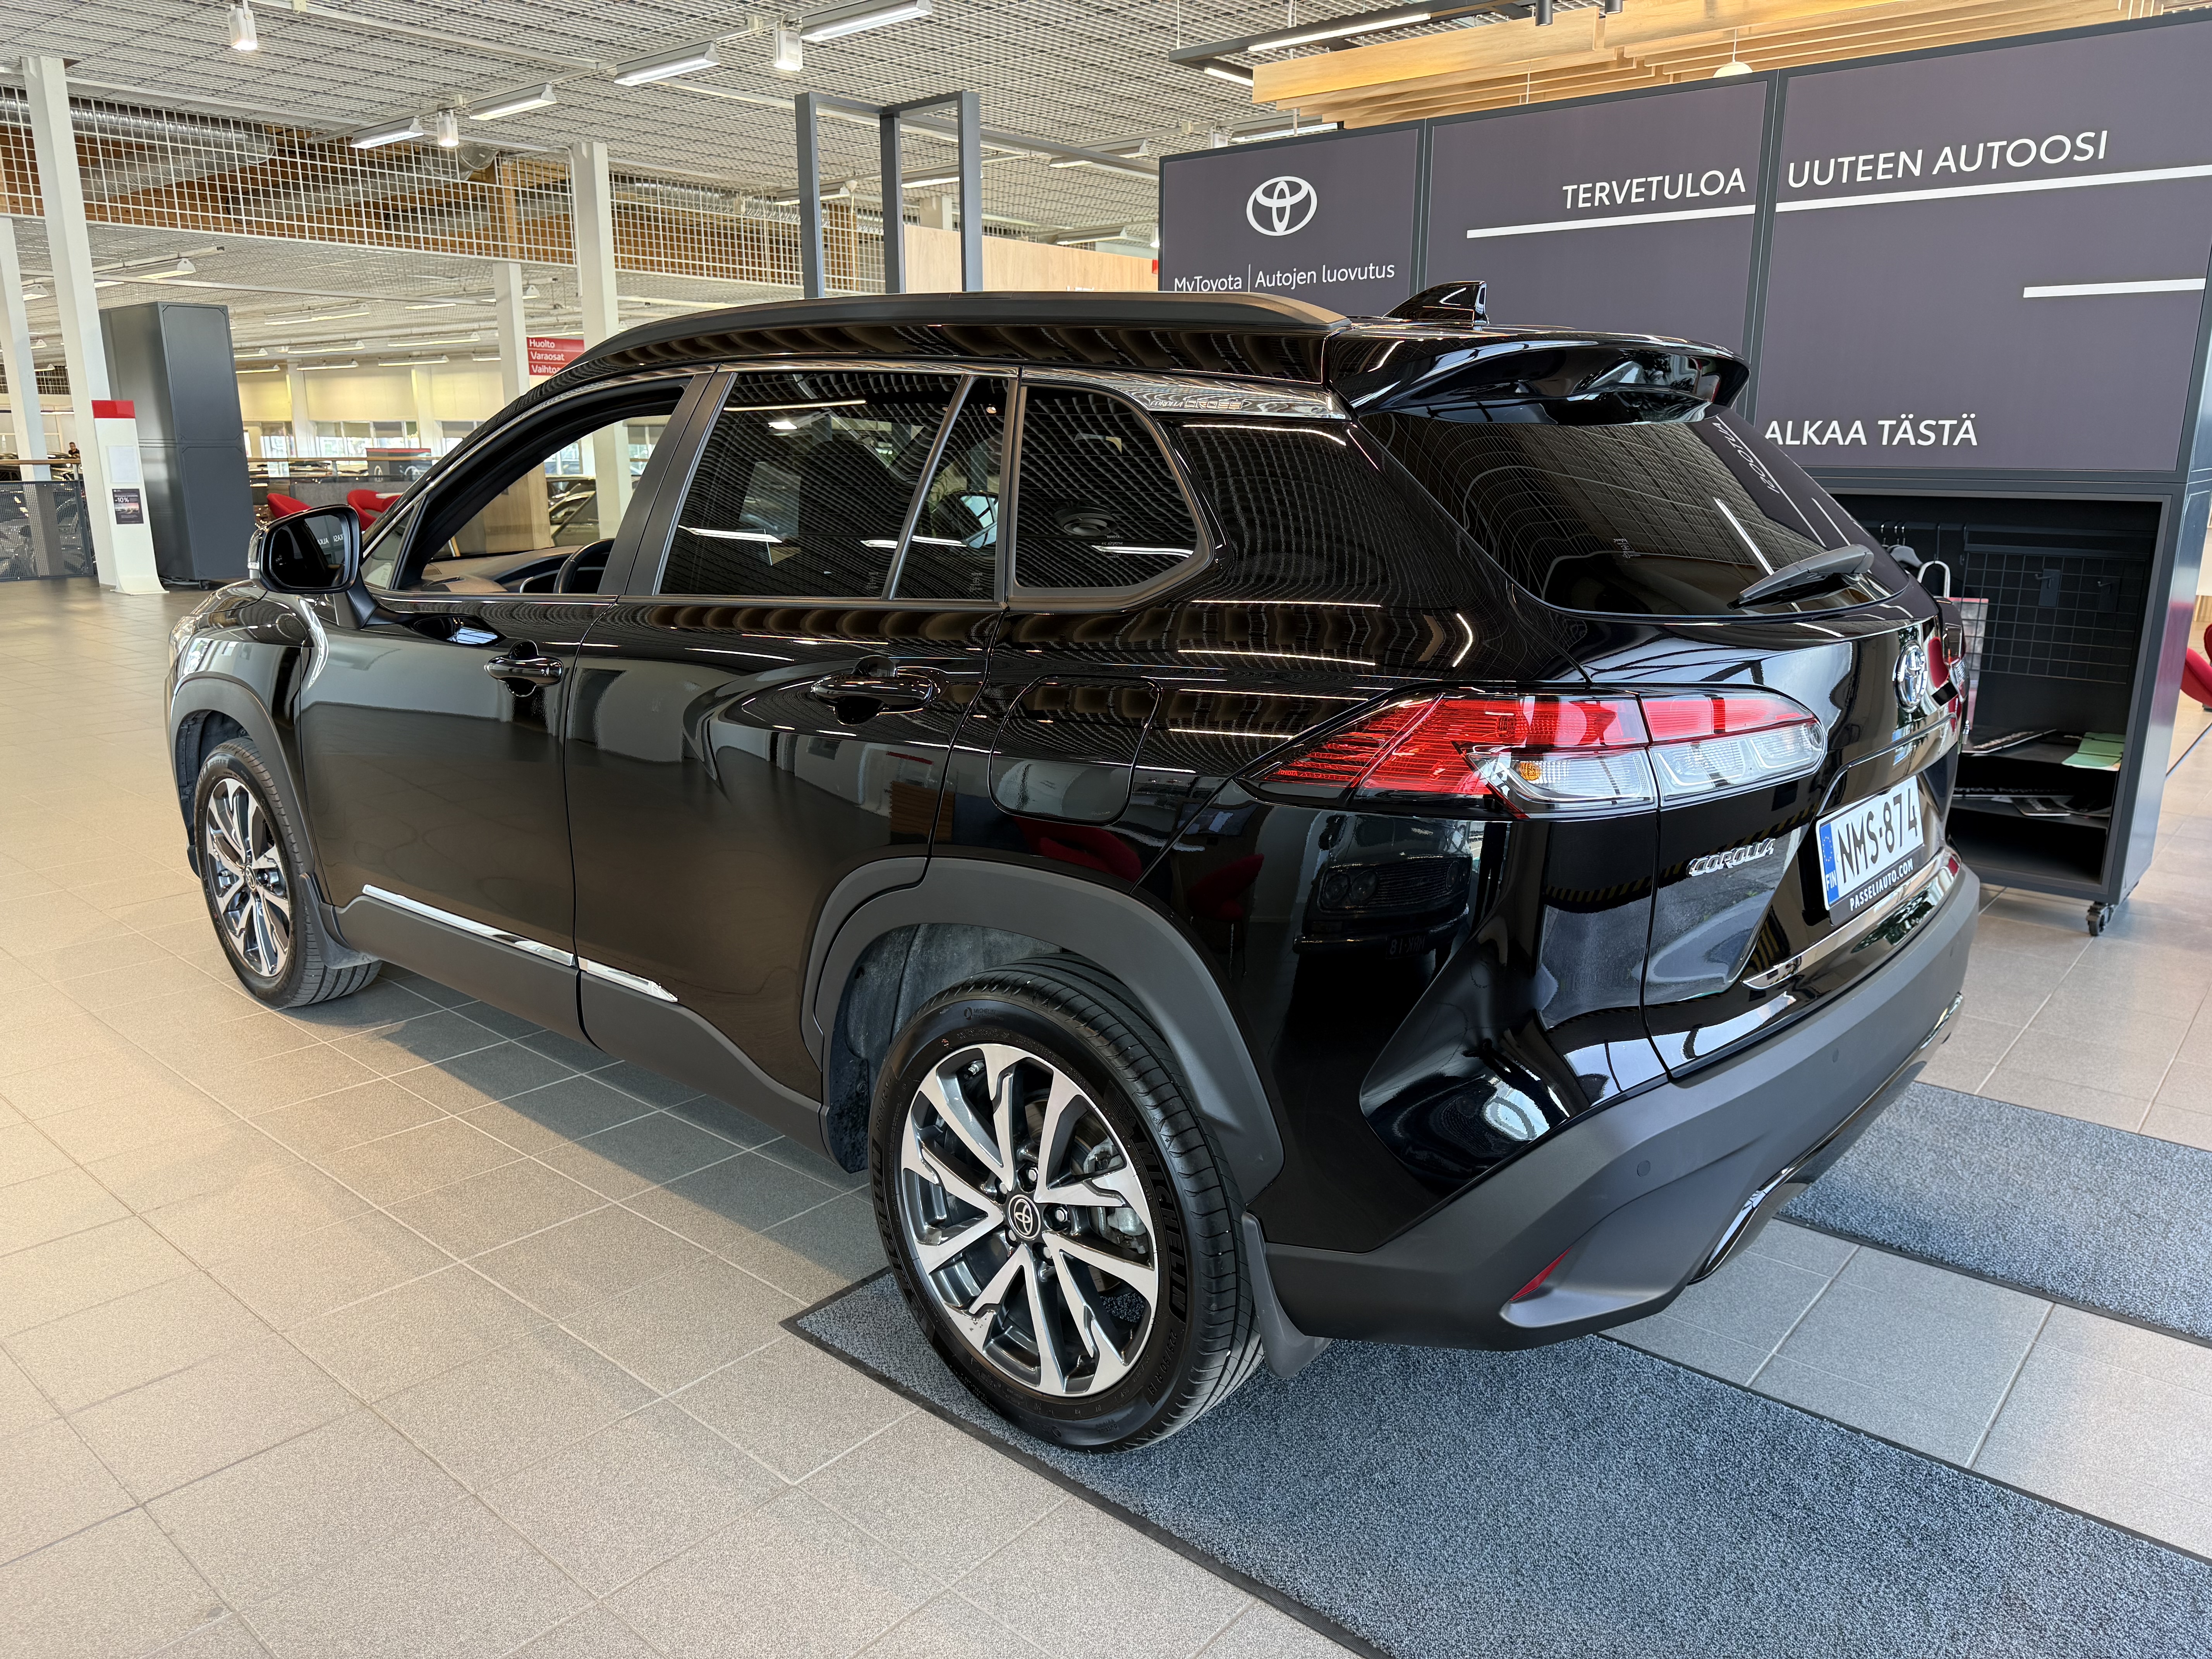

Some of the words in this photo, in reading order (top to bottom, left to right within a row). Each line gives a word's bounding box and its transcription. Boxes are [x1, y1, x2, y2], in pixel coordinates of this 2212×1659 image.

[1562, 168, 1746, 209] TERVETULOA
[1788, 149, 1923, 188] UUTEEN
[1932, 130, 2107, 175] AUTOOSI
[1174, 274, 1242, 292] MyToyota
[1255, 268, 1316, 290] Autojen
[1322, 264, 1395, 283] luovutus
[529, 339, 555, 349] Huolto
[530, 351, 565, 361] Varaosat
[1764, 420, 1867, 445] ALKAA
[1878, 413, 1977, 446] TÄSTÄ
[1836, 787, 1919, 884] NMS-874
[1687, 837, 1776, 877] COROLLA
[1826, 869, 1837, 890] FIN
[1850, 858, 1914, 912] PASSELIAUTO.COM
[1135, 1140, 1188, 1314] MICHELIN
[1154, 1372, 1164, 1384] R
